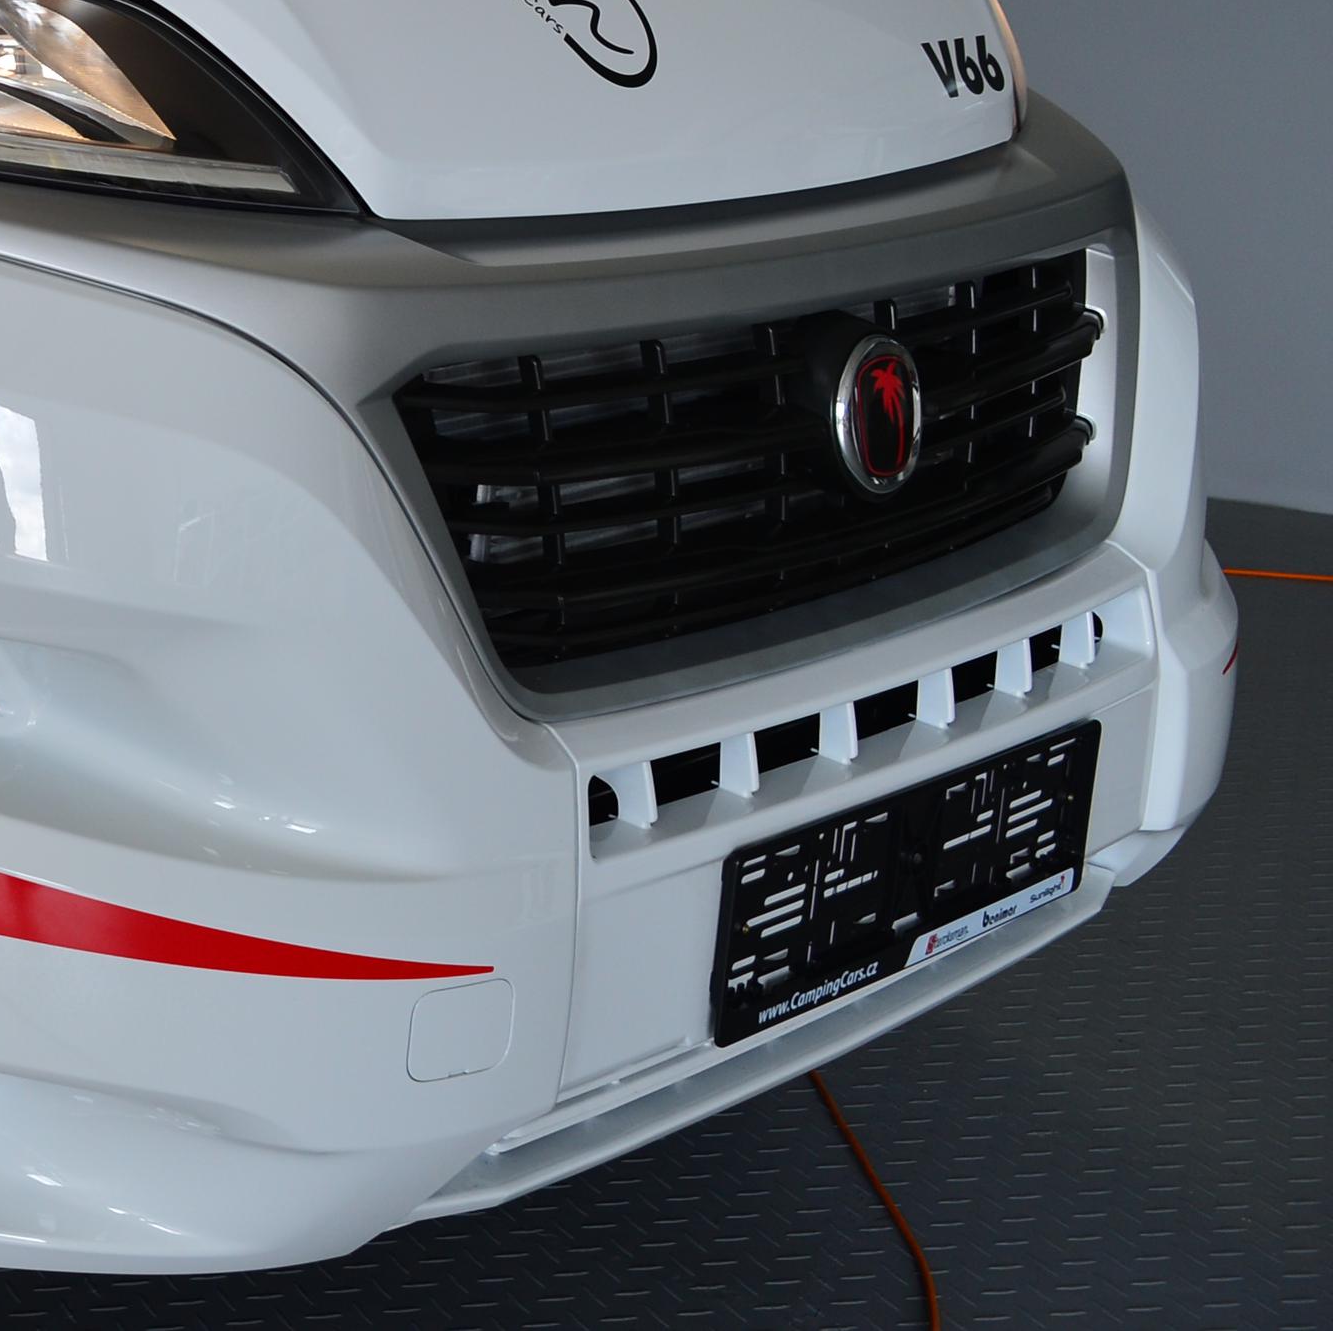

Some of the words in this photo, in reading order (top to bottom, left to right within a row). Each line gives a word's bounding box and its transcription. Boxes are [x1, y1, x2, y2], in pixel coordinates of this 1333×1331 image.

[921, 35, 1006, 99] V66
[982, 905, 1018, 928] benimar
[1029, 875, 1064, 904] Sunlight
[758, 960, 879, 1024] www.CampingCars.cz
